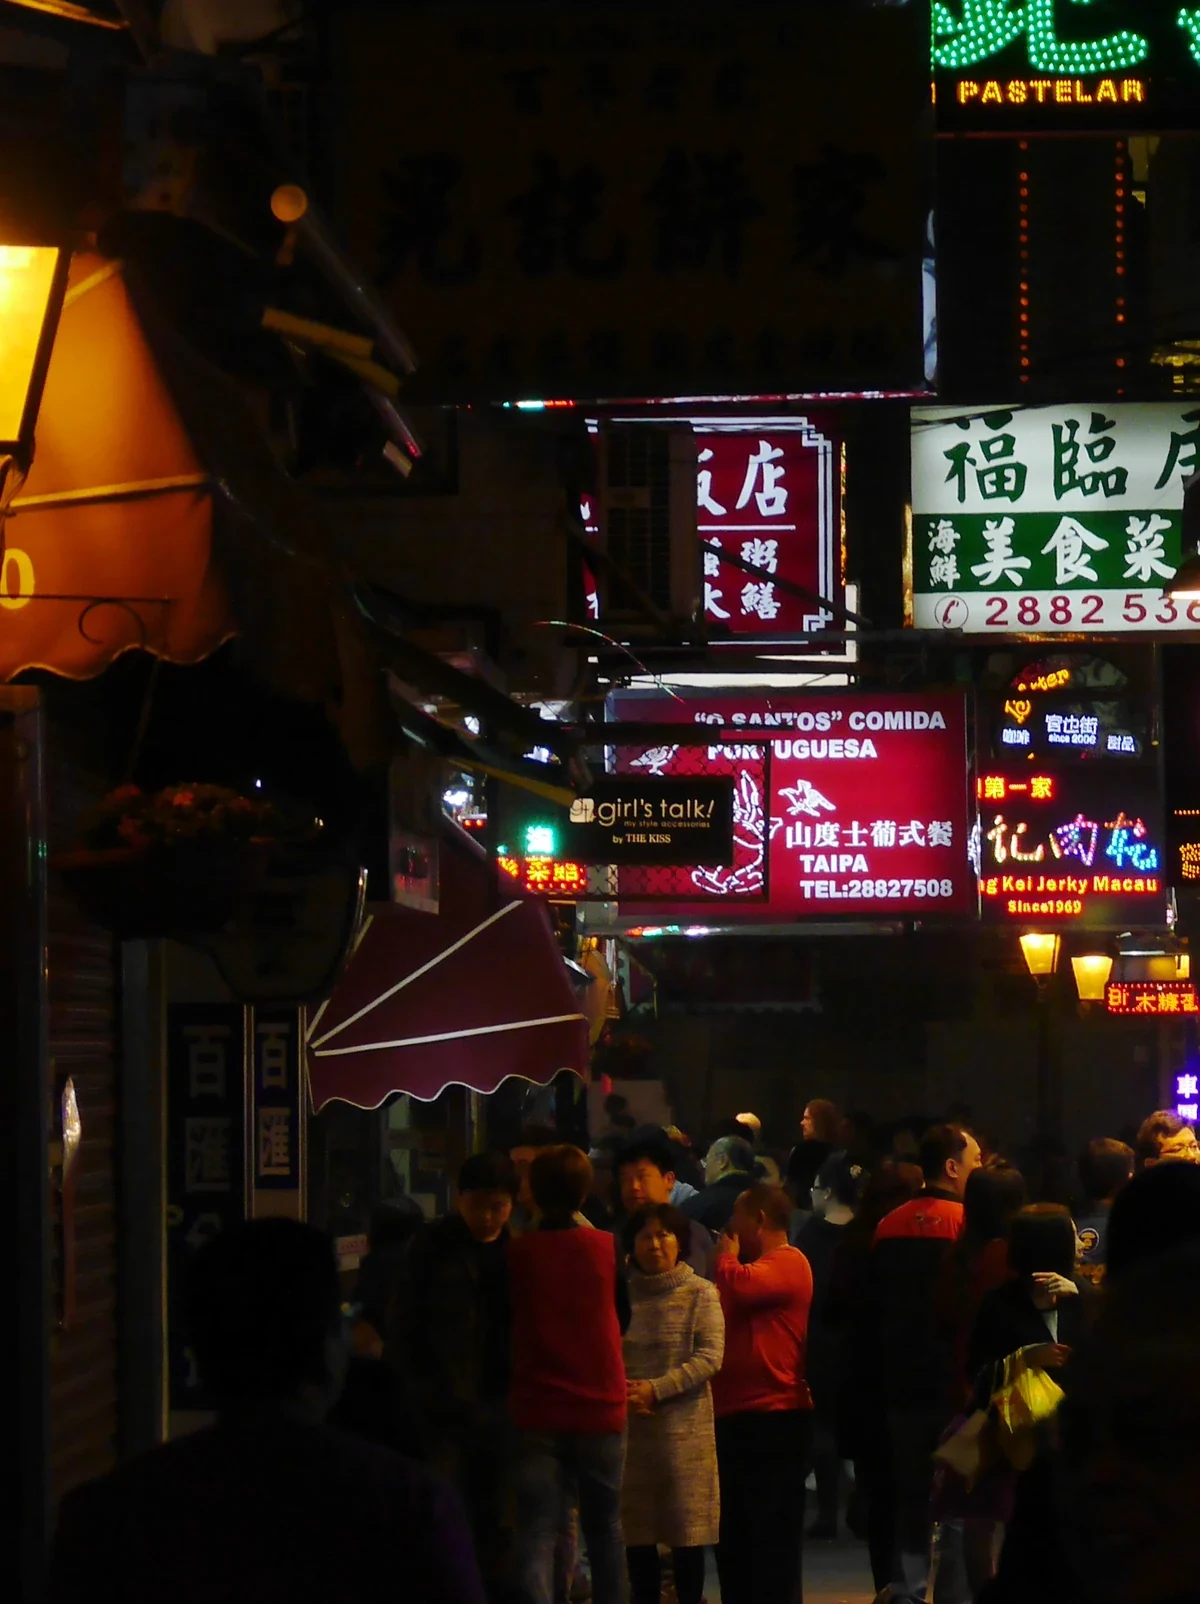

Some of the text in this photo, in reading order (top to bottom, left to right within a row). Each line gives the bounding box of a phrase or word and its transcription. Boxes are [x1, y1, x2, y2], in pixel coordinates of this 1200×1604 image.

[959, 79, 1142, 103] PASTELAR
[927, 518, 961, 589] 海鮮
[985, 595, 1104, 626] 2882
[849, 711, 946, 730] COMIDA
[598, 798, 653, 827] girl's
[660, 799, 715, 818] talk!
[639, 820, 658, 828] style
[612, 833, 671, 844] by THE KISS
[786, 821, 953, 848] 山度士葡式餐
[800, 855, 868, 872] TAIPA
[800, 880, 953, 898] TEL:28827508
[1002, 876, 1032, 892] Kei
[1036, 875, 1087, 894] Jerky
[1093, 876, 1157, 892] Macau
